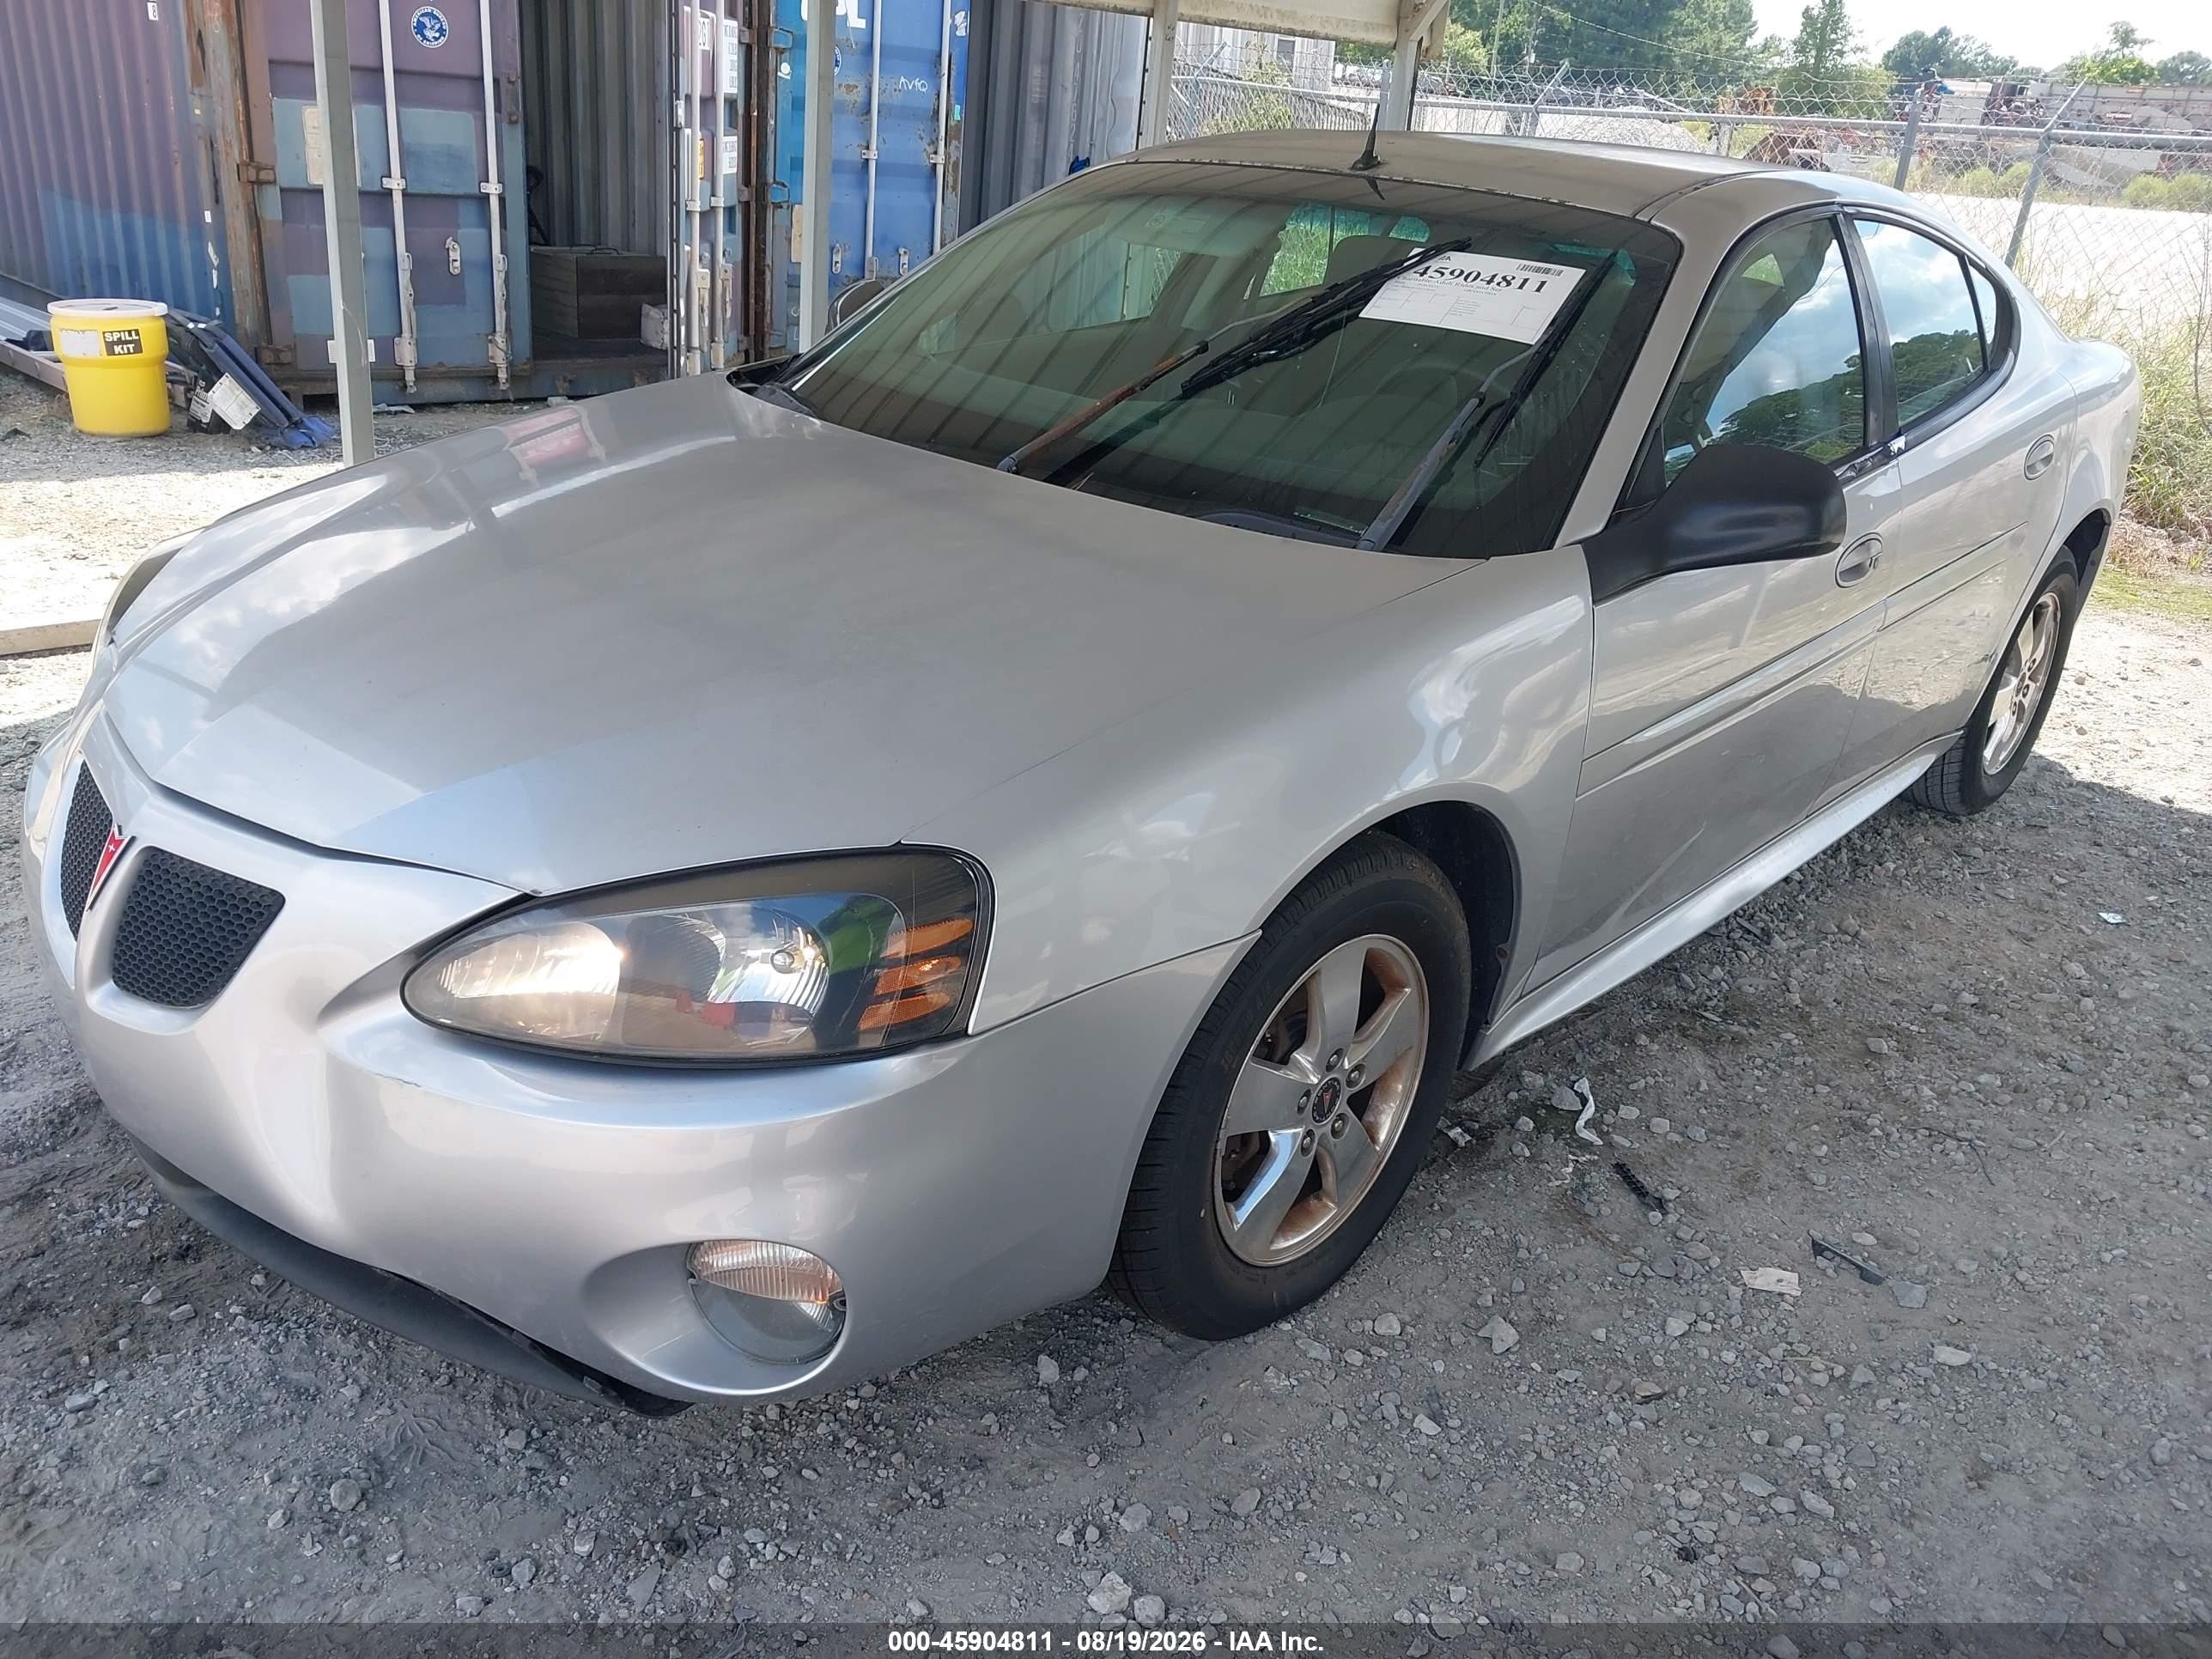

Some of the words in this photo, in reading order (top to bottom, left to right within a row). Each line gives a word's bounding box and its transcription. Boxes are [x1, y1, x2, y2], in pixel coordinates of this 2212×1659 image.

[1413, 265, 1548, 294] 45904811
[104, 330, 139, 342] SPILL
[113, 343, 135, 355] KIT
